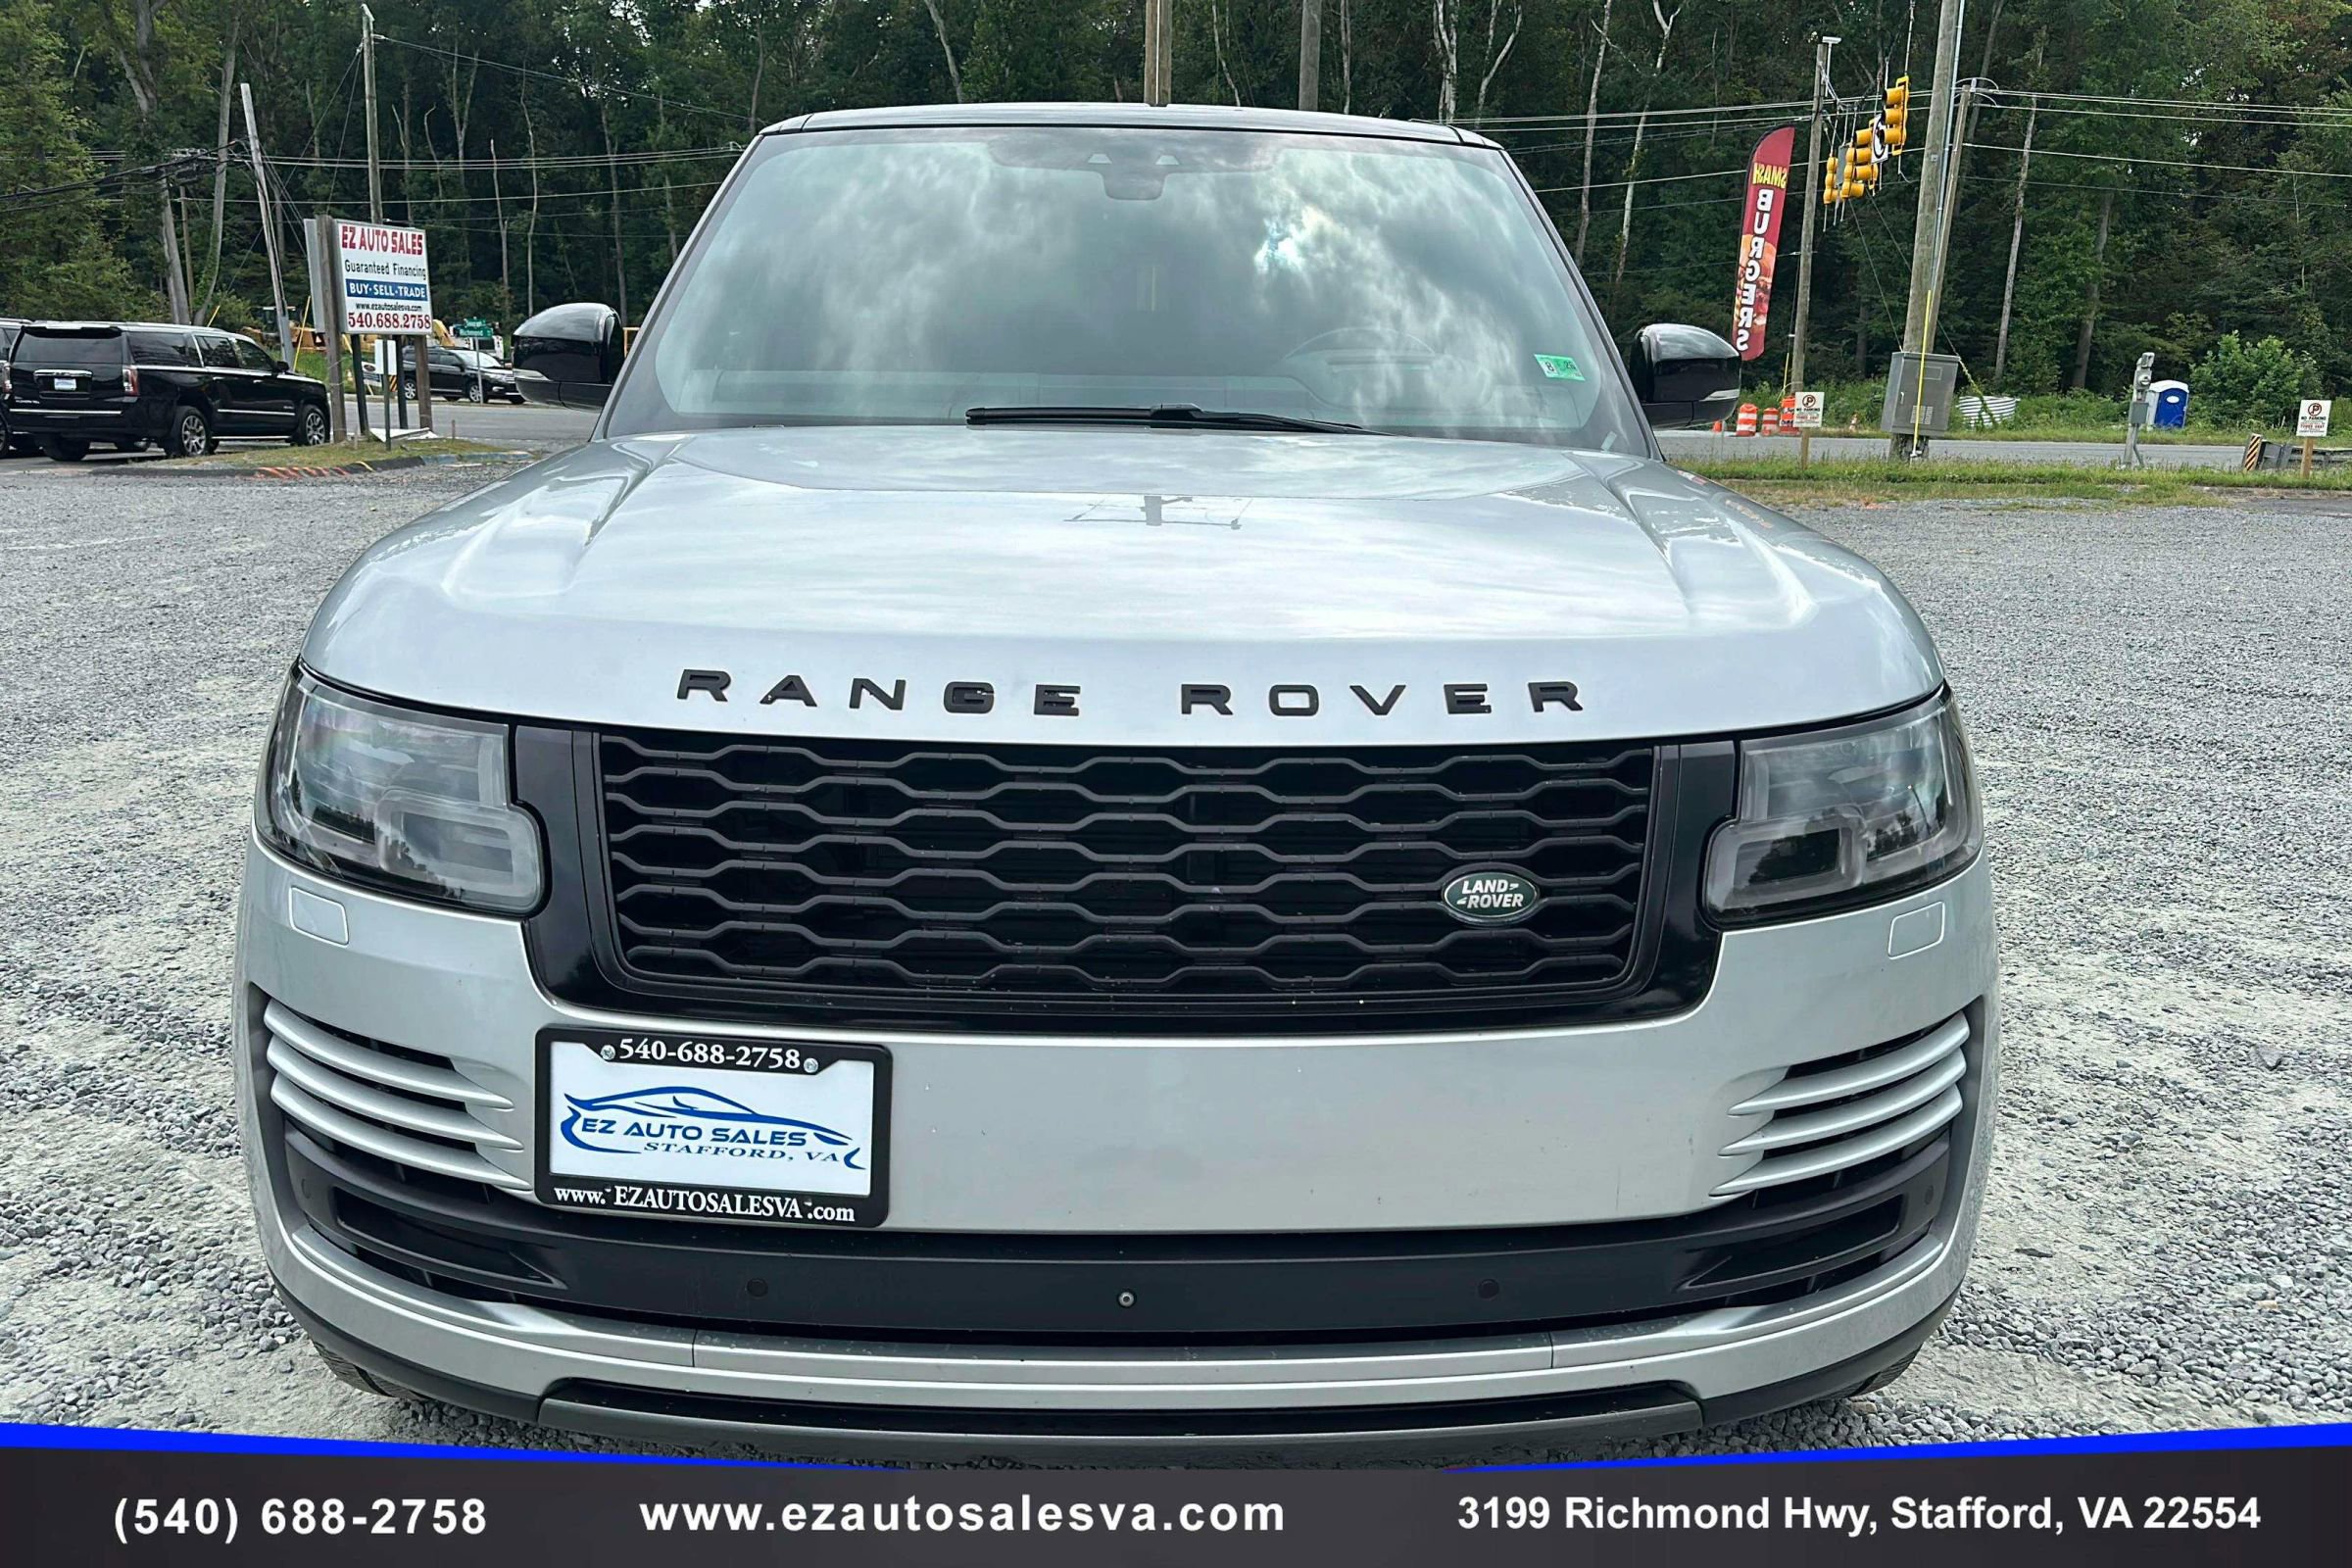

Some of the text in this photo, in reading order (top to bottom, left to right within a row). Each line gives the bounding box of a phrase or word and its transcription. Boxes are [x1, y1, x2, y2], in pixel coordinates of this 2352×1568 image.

[341, 225, 422, 255] EZ AUTO SALES
[344, 259, 426, 280] Guaranteed Financing
[348, 312, 431, 329] 540.688.2758
[356, 302, 422, 312] www.ezautosalesva.com
[676, 668, 1584, 716] RANGE ROVER
[1461, 879, 1524, 908] LAND ROVER
[618, 1038, 801, 1070] 540-688-2758
[581, 1117, 807, 1147] EZ AUTO SALES
[643, 1141, 839, 1163] STAFFORD, VA
[554, 1187, 606, 1205] www.
[613, 1185, 803, 1219] EZAUTOSALESVA
